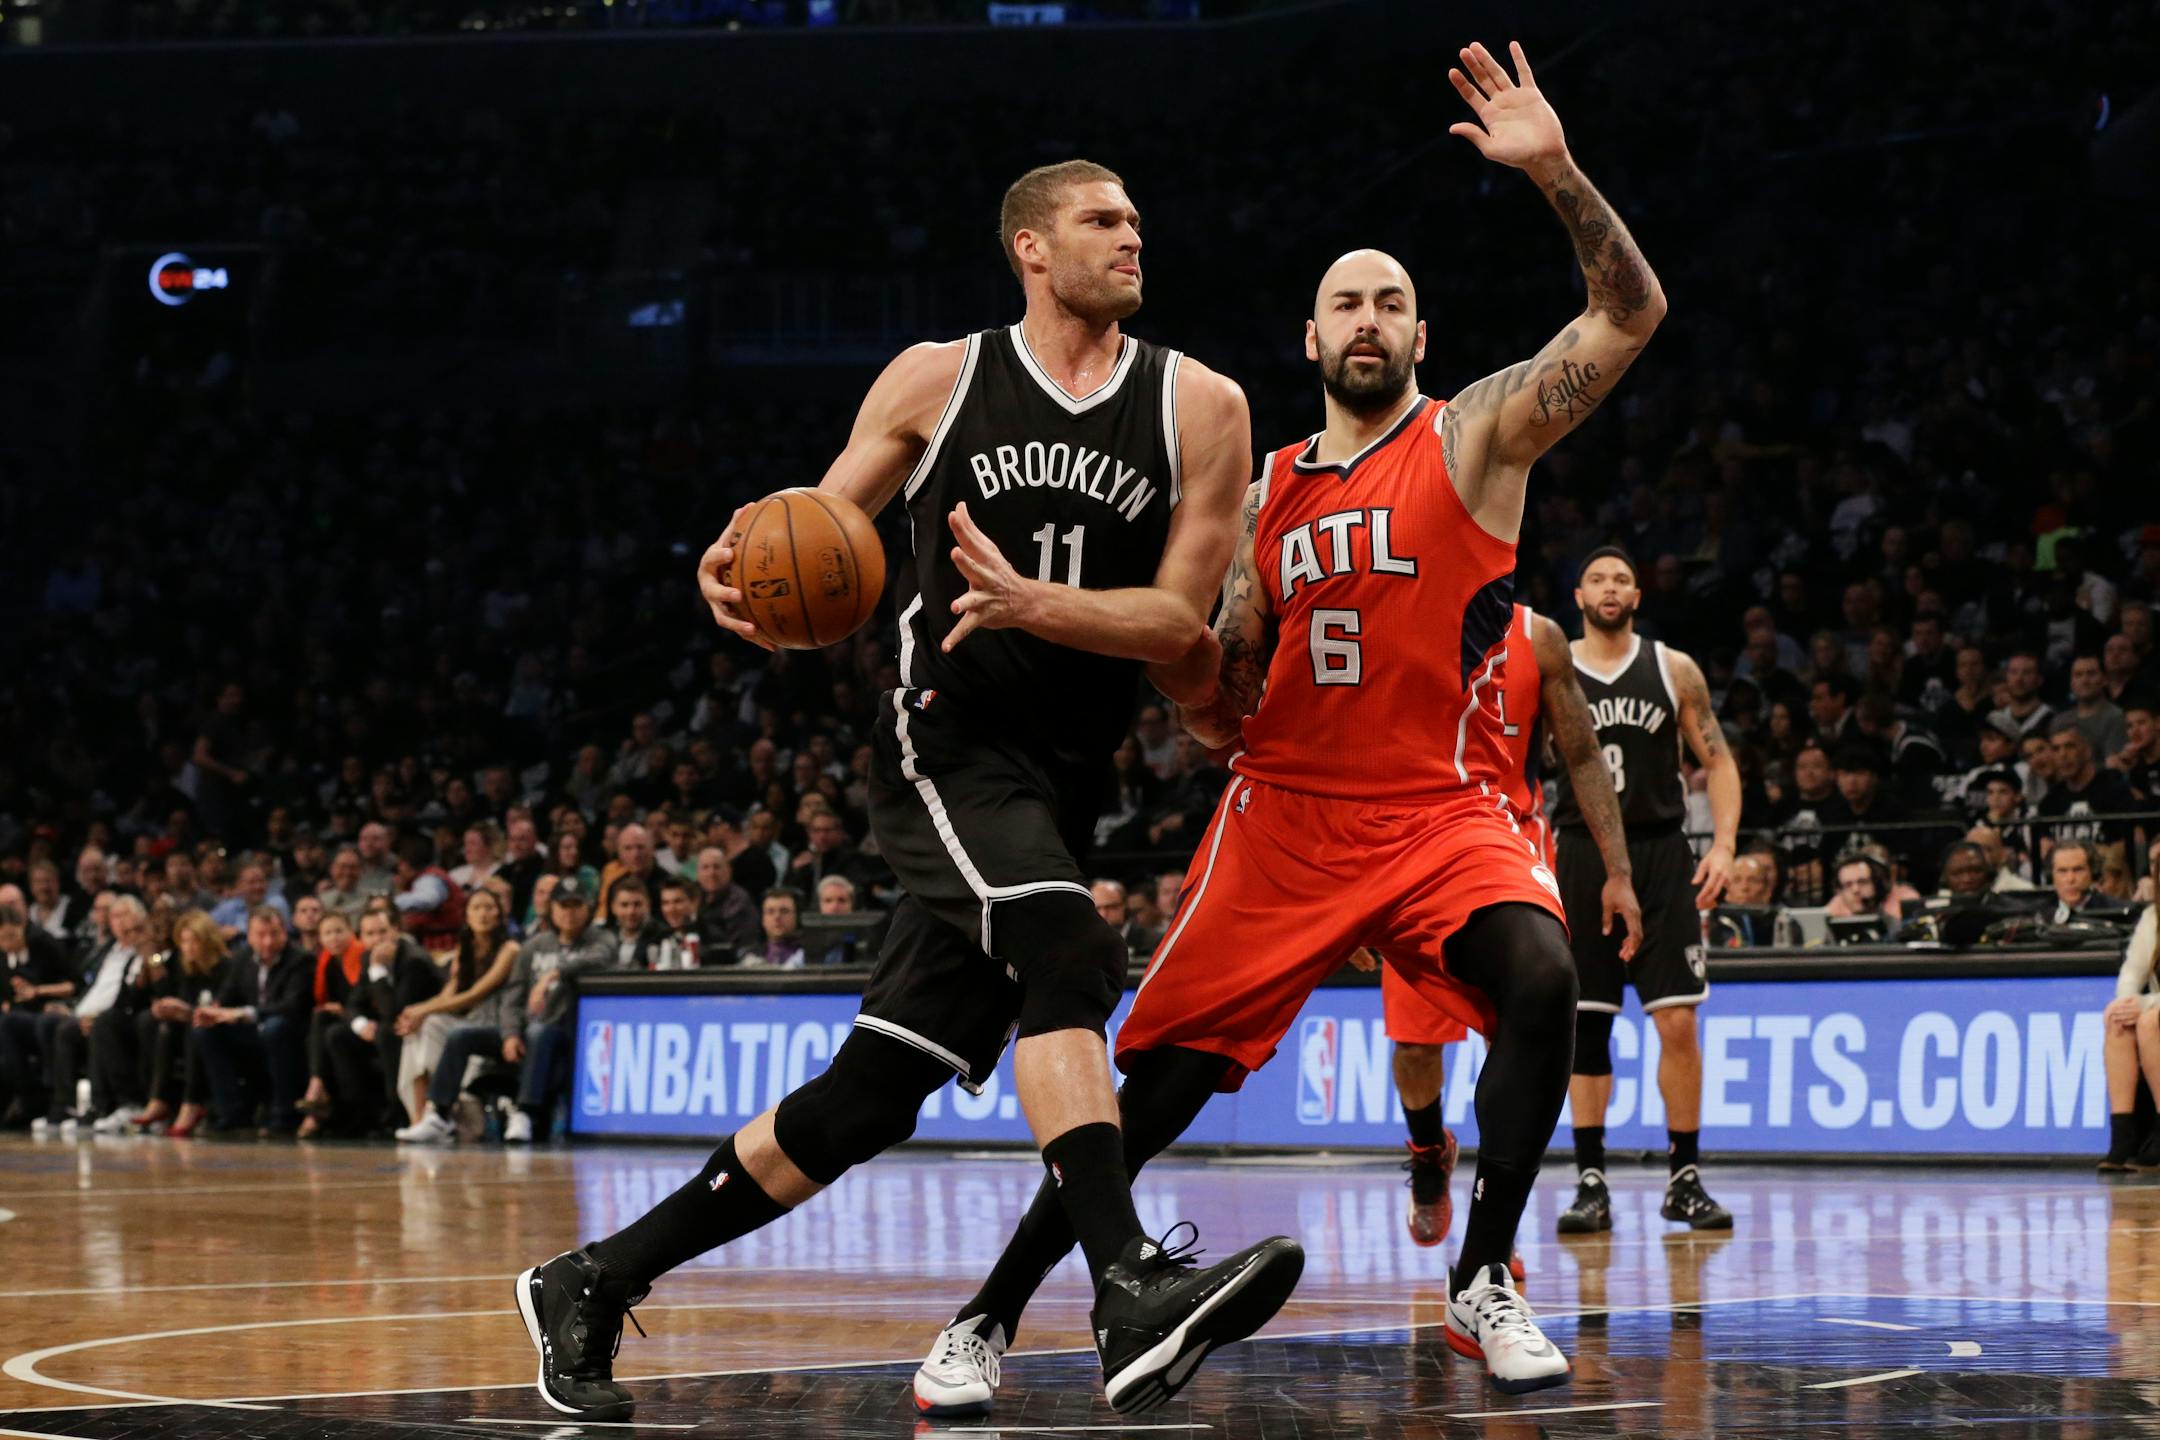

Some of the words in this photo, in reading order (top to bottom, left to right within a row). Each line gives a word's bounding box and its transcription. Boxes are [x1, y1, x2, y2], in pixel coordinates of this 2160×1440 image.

[970, 440, 1158, 522] BROOKLYN
[1032, 522, 1086, 590] 11
[1279, 506, 1419, 603] ATL
[1308, 608, 1363, 687] 6
